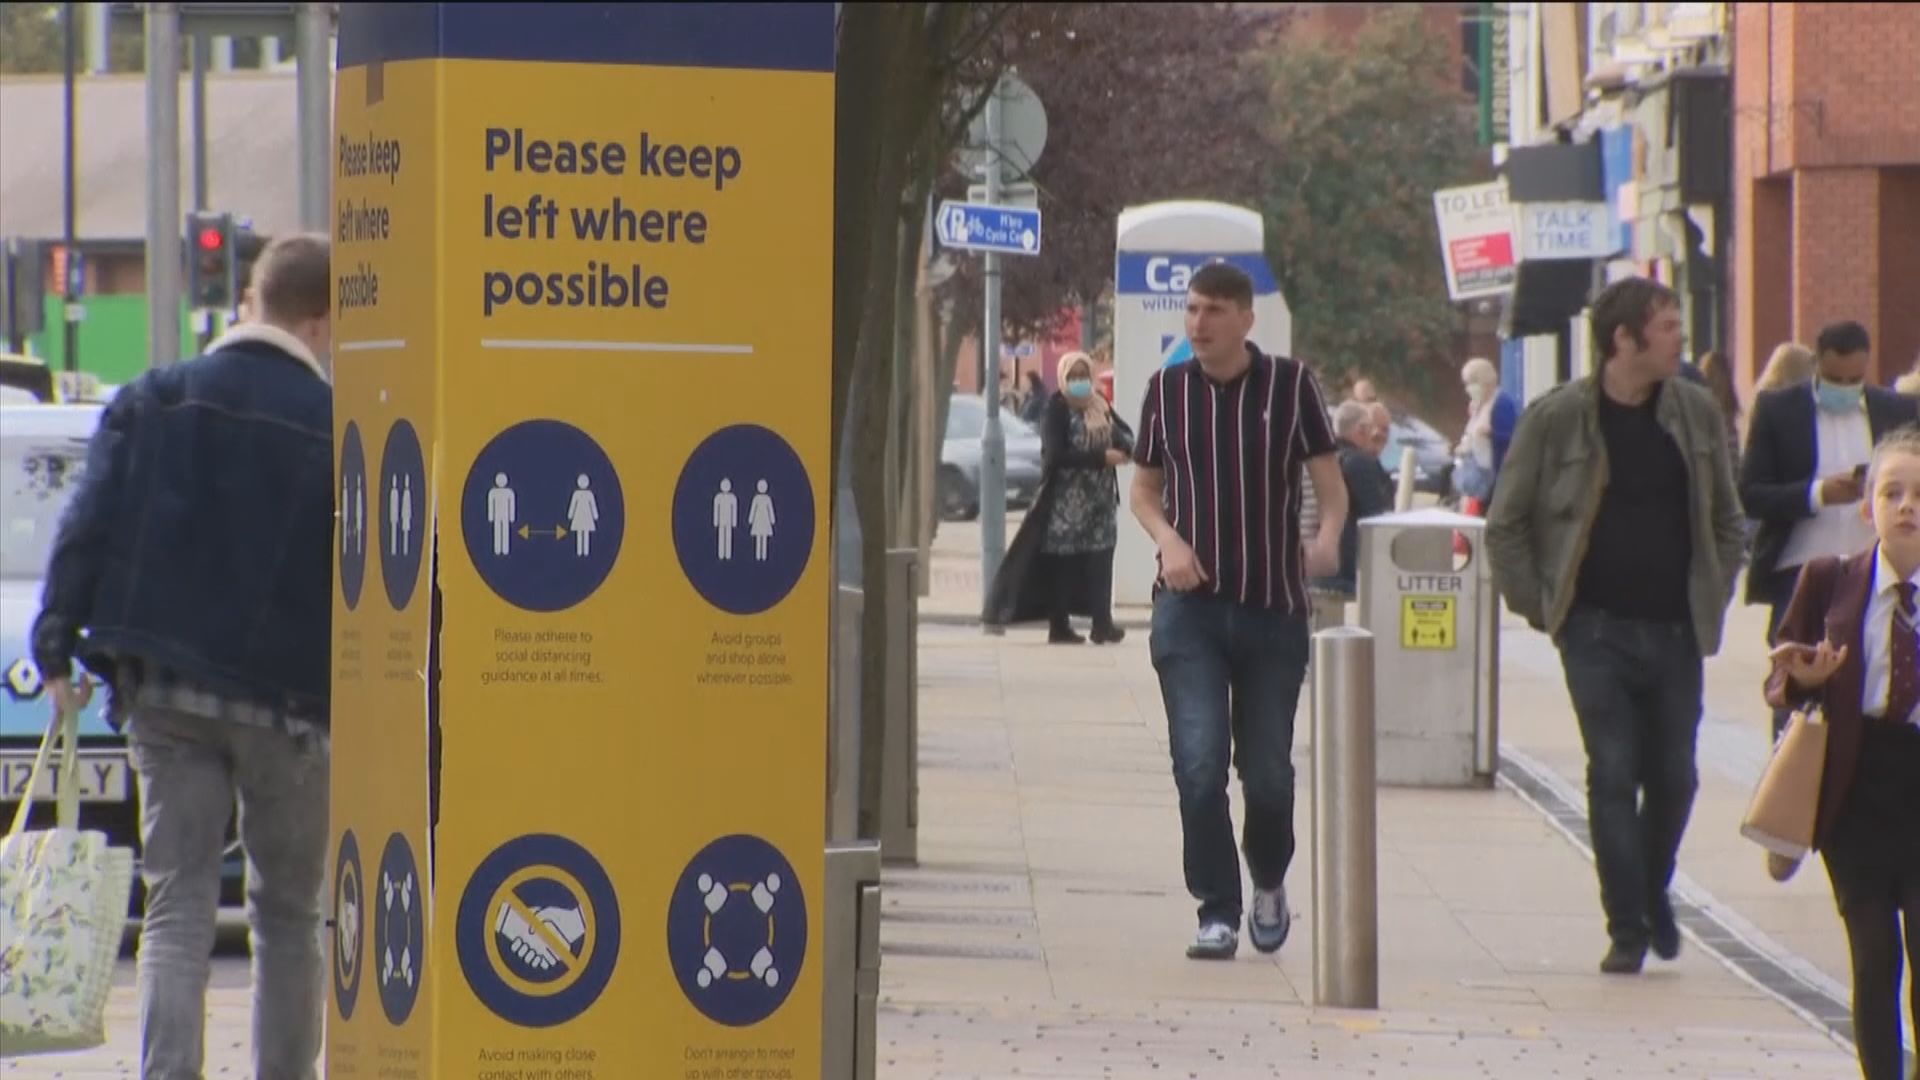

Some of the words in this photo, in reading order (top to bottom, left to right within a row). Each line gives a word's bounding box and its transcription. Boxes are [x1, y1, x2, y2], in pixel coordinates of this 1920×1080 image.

[340, 133, 367, 177] Please
[369, 130, 401, 185] keep
[484, 128, 626, 175] Please
[639, 132, 742, 191] keep
[1440, 193, 1467, 215] TO
[338, 198, 353, 243] left
[355, 197, 390, 242] where
[483, 194, 559, 239] left
[570, 197, 708, 244] where
[1534, 208, 1592, 228] TALK
[1534, 231, 1592, 249] TIME
[1146, 257, 1203, 292] Ca
[338, 259, 378, 320] possible
[483, 261, 669, 316] possible
[1397, 575, 1462, 592] LITTER
[494, 628, 532, 643] Please
[535, 628, 577, 643] adhere
[580, 630, 593, 643] to
[711, 631, 742, 645] Avoid
[745, 632, 782, 648] groups
[495, 648, 528, 663] social
[531, 648, 591, 666] distancing
[705, 650, 726, 665] and
[729, 651, 755, 668] shop
[757, 651, 786, 665] alone
[481, 668, 538, 685] guidance
[540, 670, 551, 682] at
[554, 668, 566, 682] all
[696, 671, 746, 684] wherever
[48, 764, 111, 795] TY
[478, 1047, 514, 1061] Avoid
[518, 1047, 562, 1064] making
[565, 1047, 597, 1061] close
[684, 1046, 713, 1061] Don't
[715, 1048, 754, 1064] arrange
[757, 1047, 767, 1060] to
[769, 1047, 795, 1061] meet
[478, 1068, 522, 1080] contact
[526, 1068, 552, 1080] with
[702, 1067, 724, 1080] with
[726, 1067, 753, 1080] other
